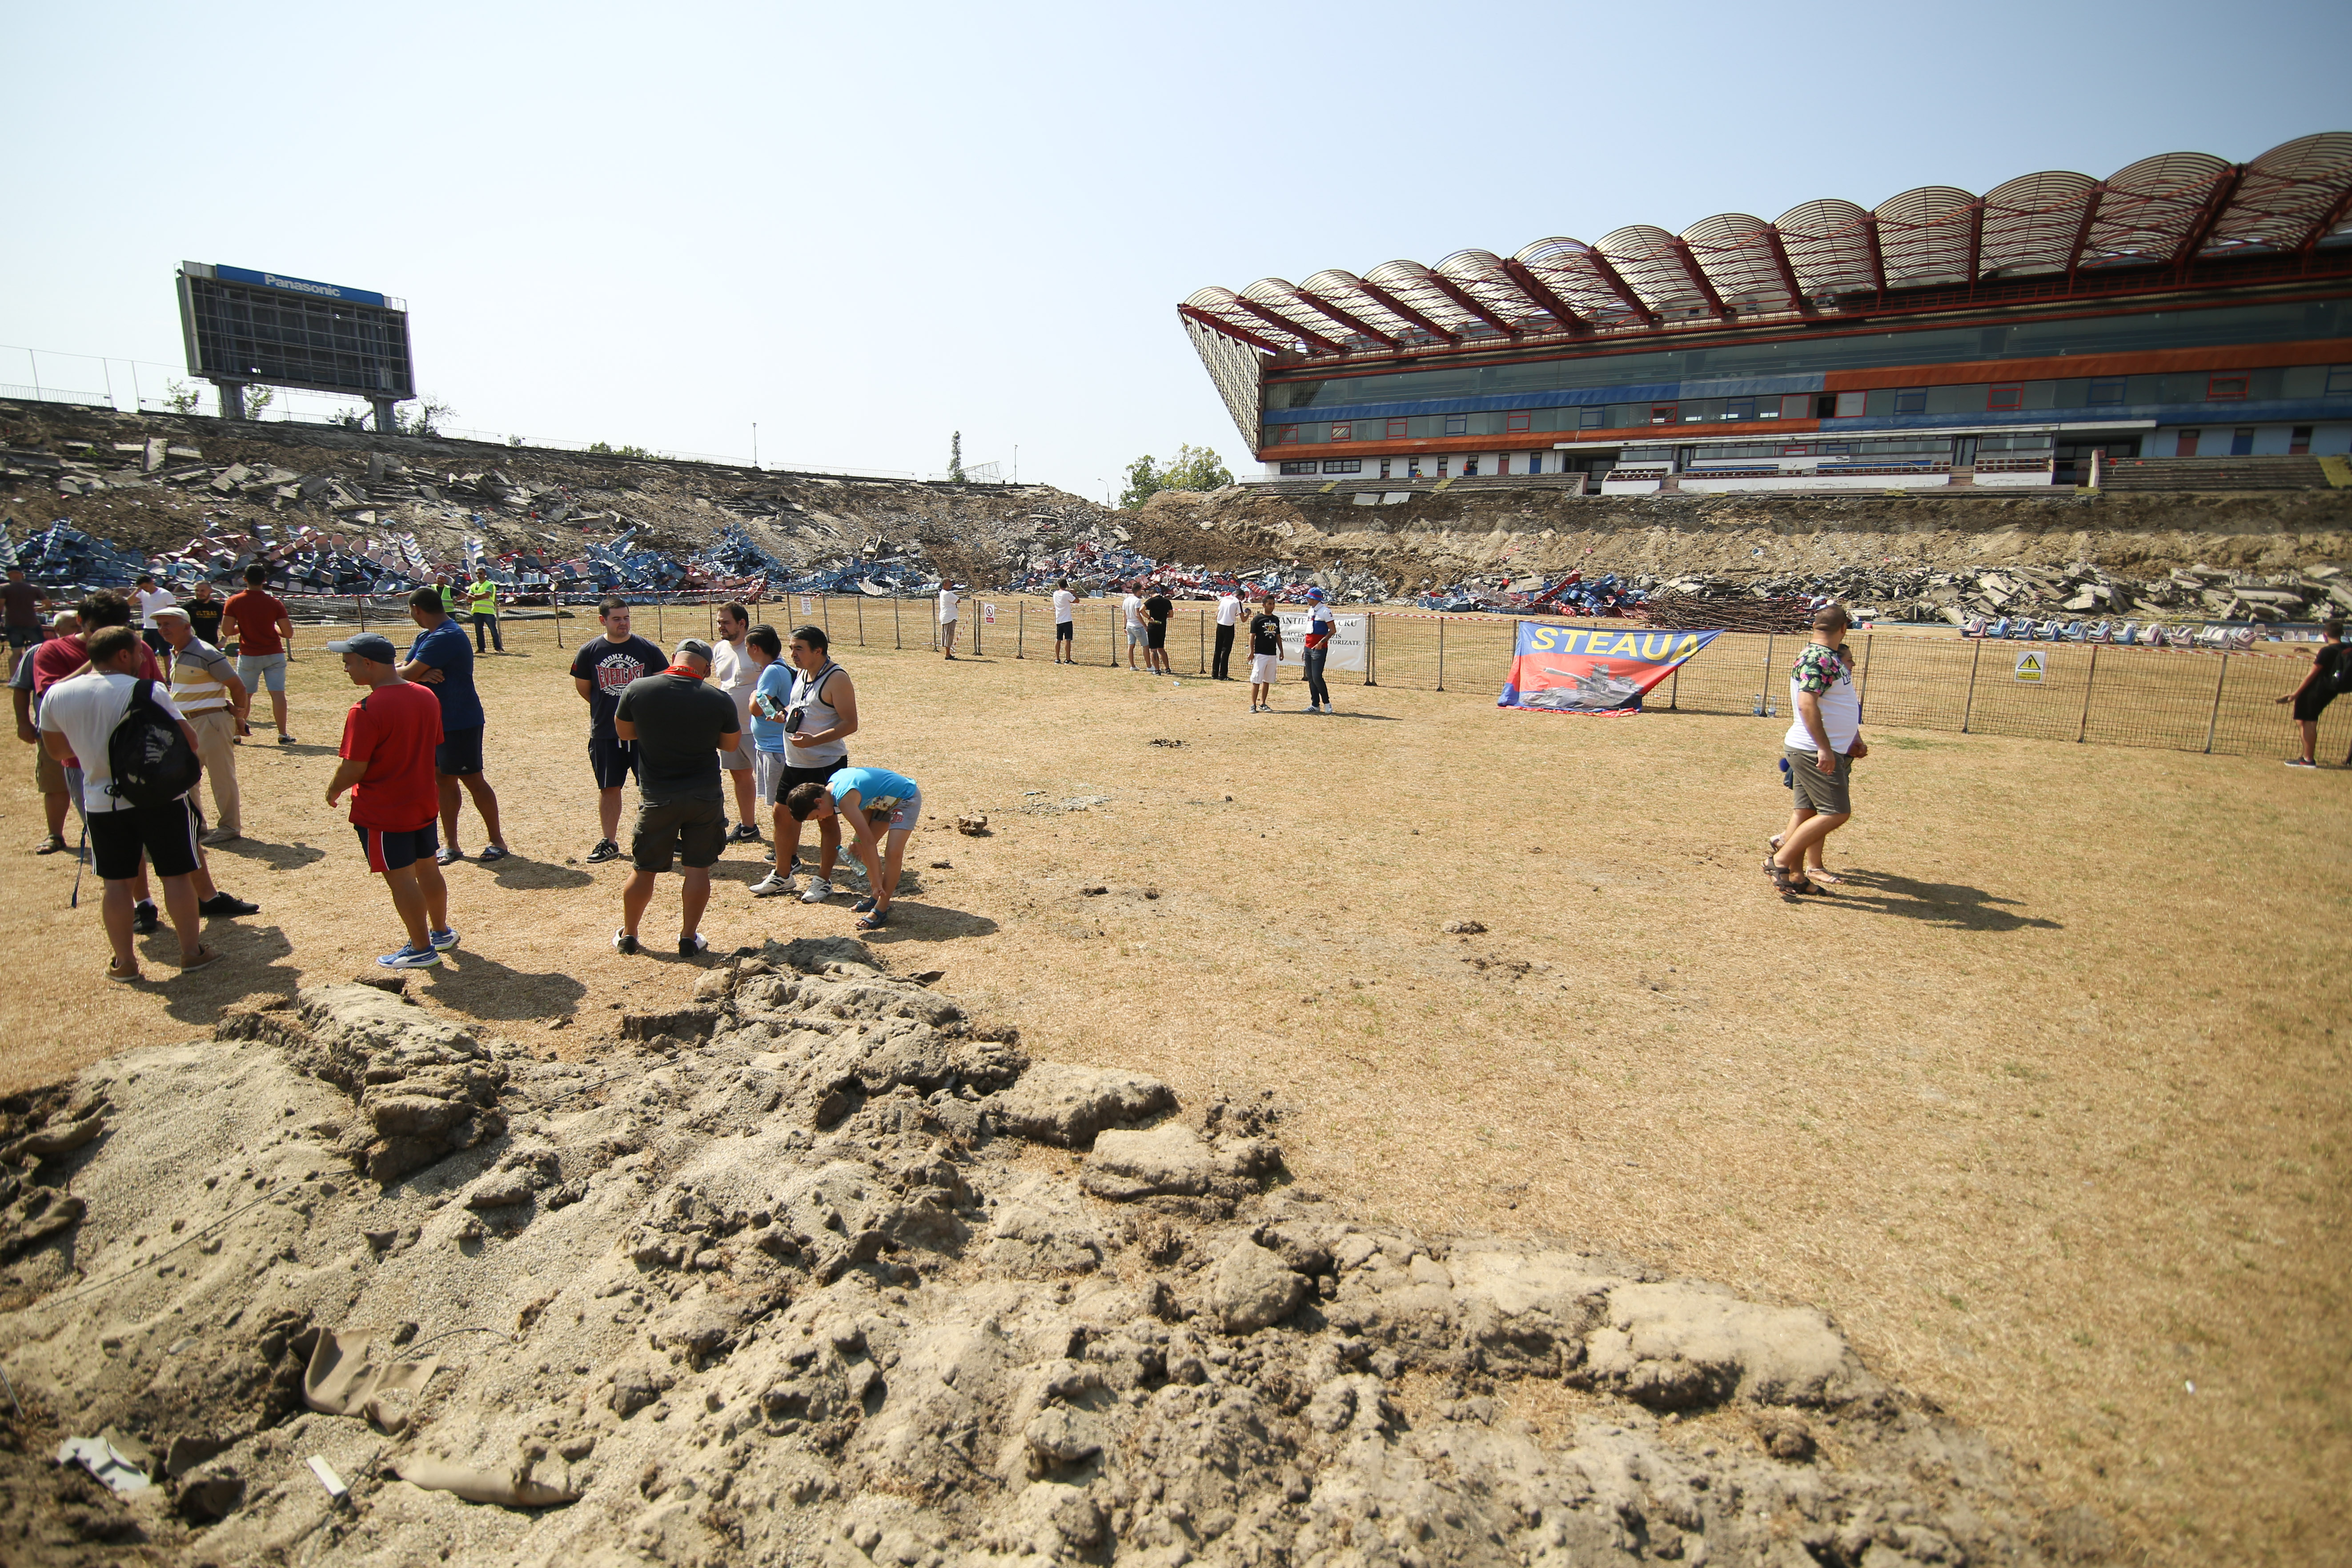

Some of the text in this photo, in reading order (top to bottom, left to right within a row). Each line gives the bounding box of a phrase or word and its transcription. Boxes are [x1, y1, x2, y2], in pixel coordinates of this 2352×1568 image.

[264, 274, 341, 297] Panasonic
[1531, 627, 1699, 663] STEAUA
[600, 654, 639, 667] BRONX NYC
[595, 663, 645, 690] EVERLAST
